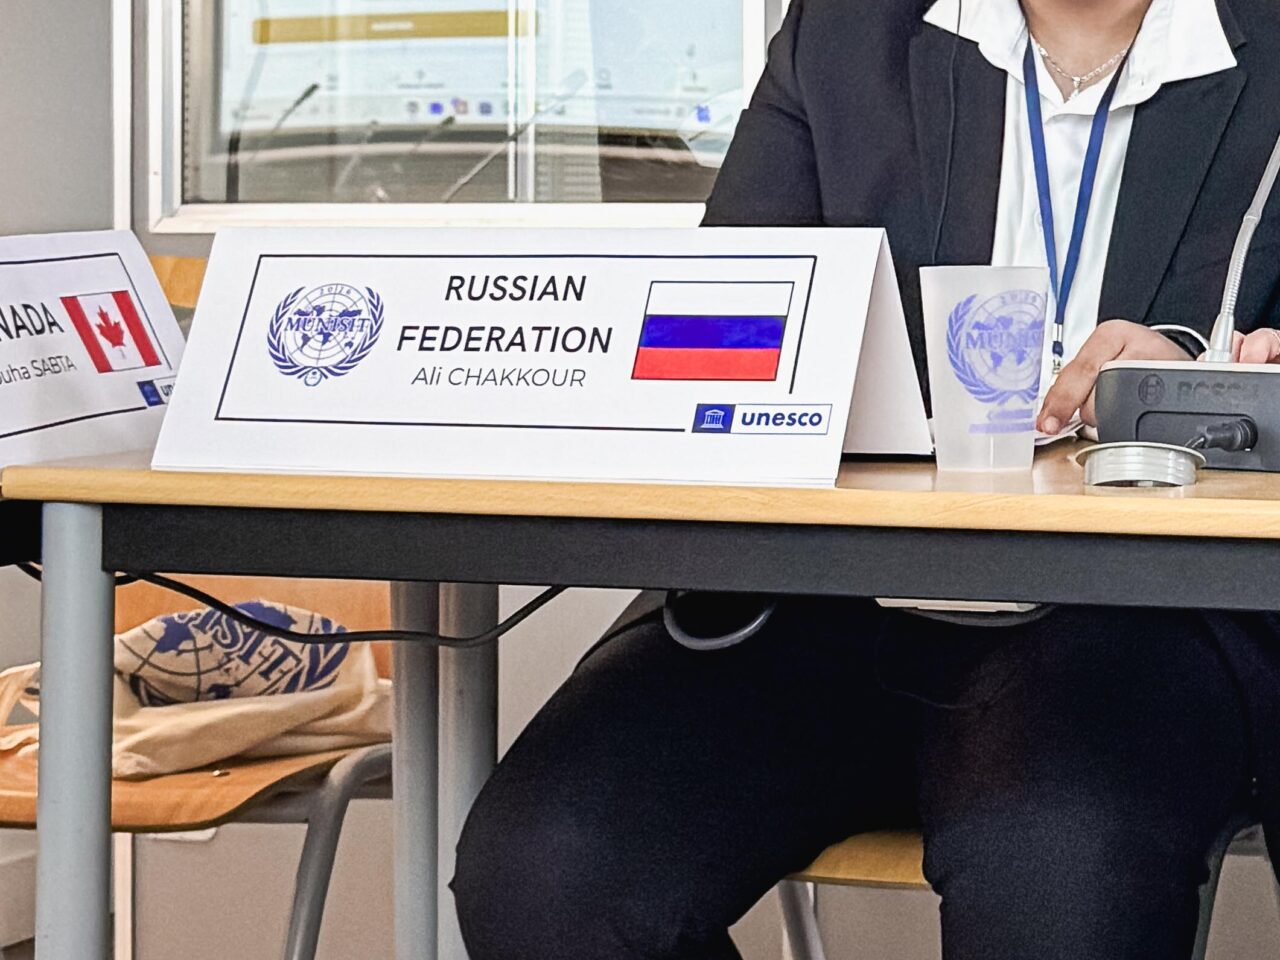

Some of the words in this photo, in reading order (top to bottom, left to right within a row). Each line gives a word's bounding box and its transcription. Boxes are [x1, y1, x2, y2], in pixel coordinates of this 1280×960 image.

[444, 275, 587, 301] RUSSIAN
[284, 317, 370, 332] MUNISIT
[396, 326, 612, 353] FEDERATION
[31, 355, 77, 378] SABTA
[411, 366, 443, 385] Ali
[448, 367, 586, 387] CHAKKOUR
[741, 412, 823, 426] unesco
